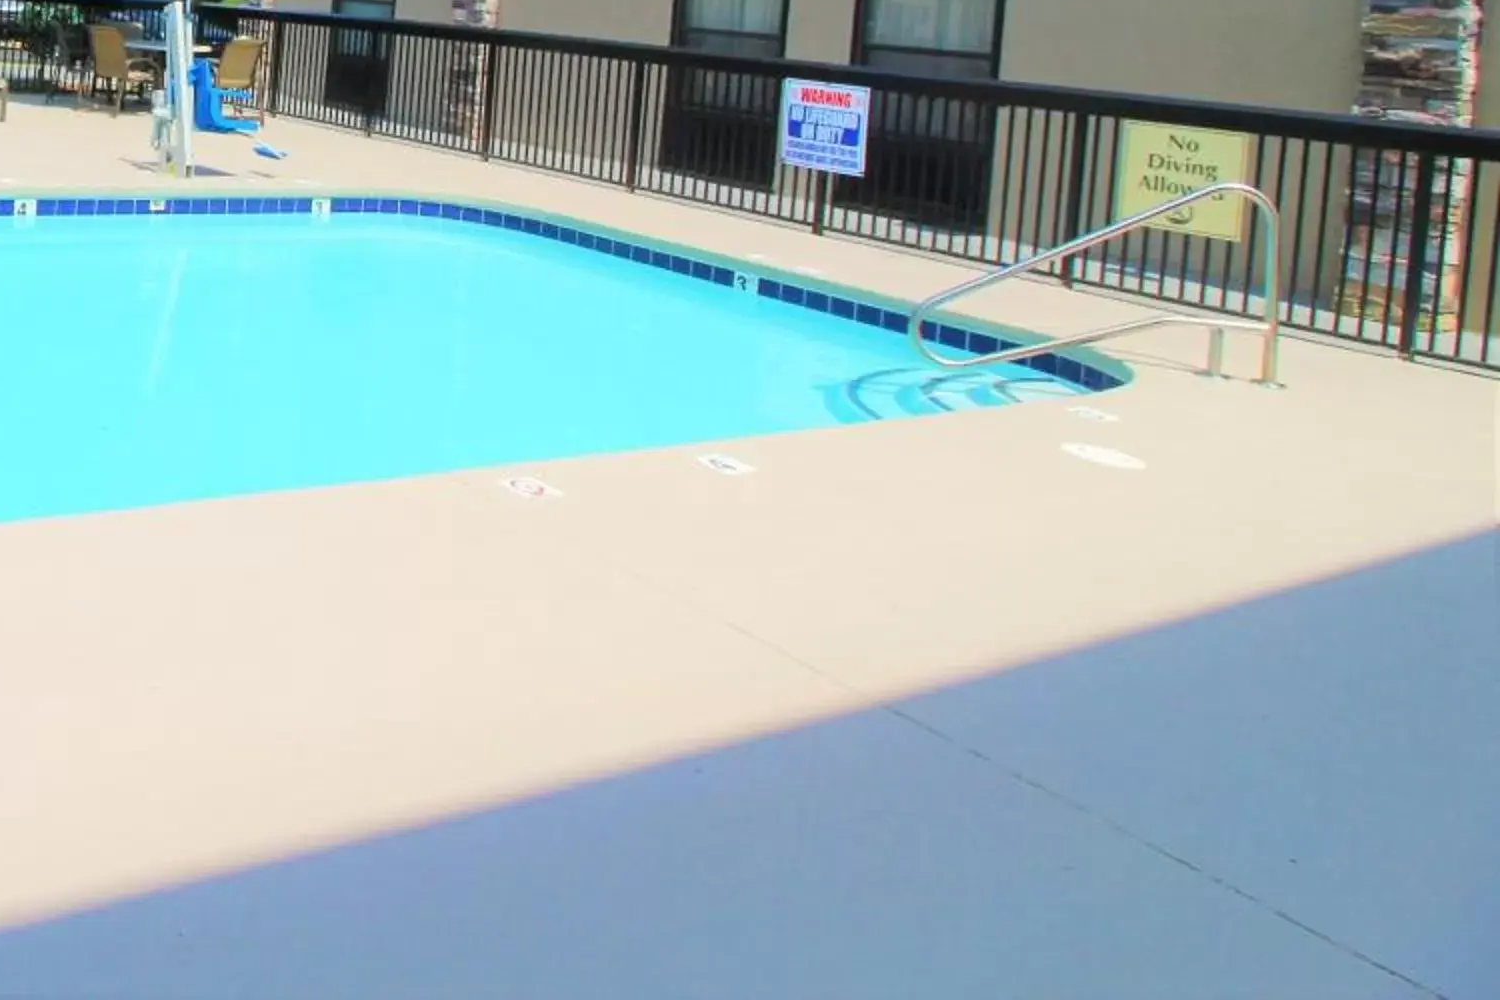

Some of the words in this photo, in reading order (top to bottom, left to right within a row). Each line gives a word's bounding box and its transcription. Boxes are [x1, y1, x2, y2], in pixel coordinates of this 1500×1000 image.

[801, 87, 852, 109] WARNING
[1167, 133, 1200, 153] No
[1147, 152, 1219, 183] Diving
